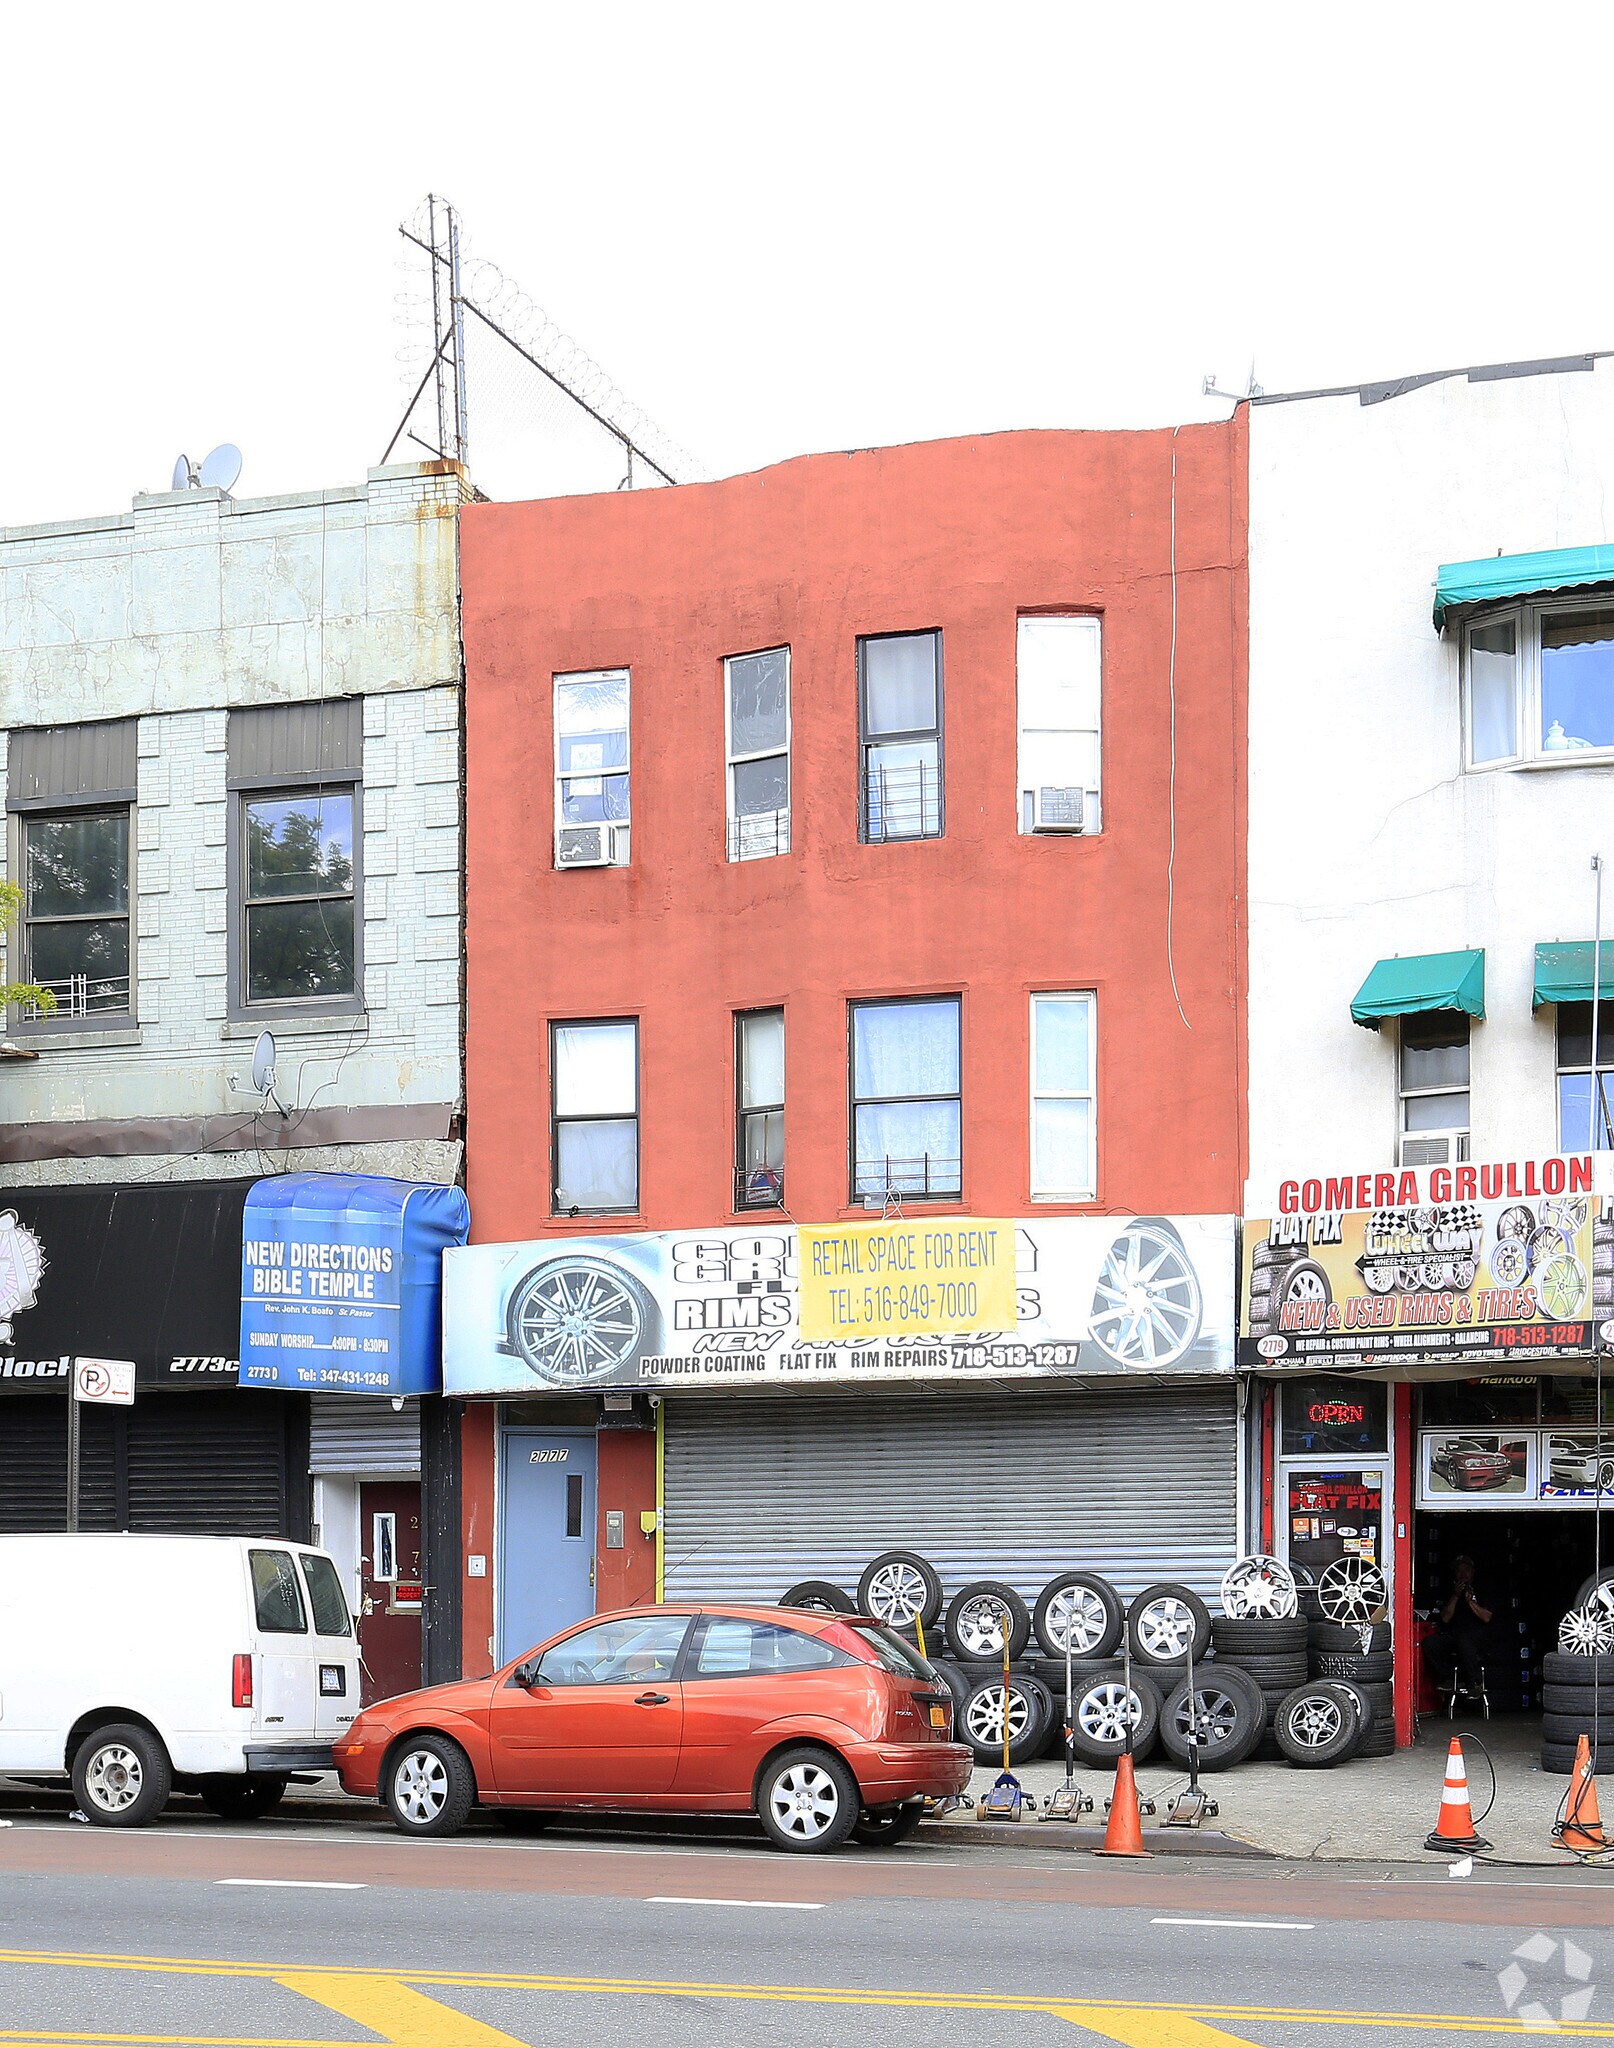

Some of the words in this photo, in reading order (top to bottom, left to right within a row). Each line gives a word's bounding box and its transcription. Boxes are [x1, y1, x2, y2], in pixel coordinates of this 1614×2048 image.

[1279, 1170, 1420, 1214] GOMERA
[1430, 1156, 1592, 1204] GRULLON
[1269, 1216, 1311, 1248] FLAT
[1313, 1214, 1343, 1245] FIX
[246, 1240, 285, 1266] NEW
[290, 1242, 393, 1273] DIRECTIONS
[813, 1238, 864, 1276] RETAIL
[868, 1234, 916, 1273] SPACE
[925, 1232, 954, 1269] FOR
[958, 1231, 998, 1268] RENT
[253, 1268, 302, 1295] BIBLE
[308, 1270, 375, 1299] TEMPLE
[264, 1303, 280, 1313] Rev.
[281, 1304, 301, 1314] John
[301, 1305, 311, 1315] K.
[311, 1306, 334, 1315] Boafo
[348, 1308, 374, 1318] Pastor
[674, 1295, 792, 1330] RIMS
[829, 1289, 860, 1325] TEL:
[864, 1281, 977, 1322] 516-849-7000
[1279, 1299, 1326, 1332] NEW
[1326, 1303, 1341, 1330] &
[1344, 1295, 1397, 1328] USED
[1399, 1291, 1454, 1326] RIMS
[1456, 1294, 1472, 1323] &
[1477, 1286, 1537, 1321] TIRES
[249, 1332, 279, 1347] SUNDAY
[363, 1337, 389, 1353] 8:30PM
[693, 1330, 785, 1353] NEW
[1262, 1339, 1284, 1353] 2779
[1295, 1339, 1305, 1351] WE
[1305, 1338, 1326, 1351] REPAIR
[1331, 1337, 1355, 1350] CUSTOM
[1356, 1336, 1373, 1349] PAINT
[1373, 1335, 1390, 1348] RIMS
[1393, 1335, 1413, 1347] WHEEL
[1413, 1333, 1451, 1347] ALIGNMENTS
[1454, 1331, 1490, 1345] BALANCING
[1492, 1324, 1585, 1347] 718-513-1287
[169, 1356, 240, 1372] 2773c
[641, 1357, 700, 1375] POWDER
[704, 1354, 766, 1373] COATING
[780, 1353, 812, 1370] FLAT
[815, 1352, 837, 1369] FIX
[851, 1351, 880, 1368] RIM
[884, 1349, 948, 1367] REPAIRS
[953, 1344, 1079, 1368] 718-513-1287
[247, 1366, 271, 1379] 2773
[297, 1368, 317, 1382] Tel:
[319, 1369, 390, 1386] 347-431-1248
[1309, 1404, 1364, 1422] OPEN
[530, 1450, 569, 1463] 2777
[1346, 1492, 1381, 1510] FIX
[410, 1516, 419, 1529] 2
